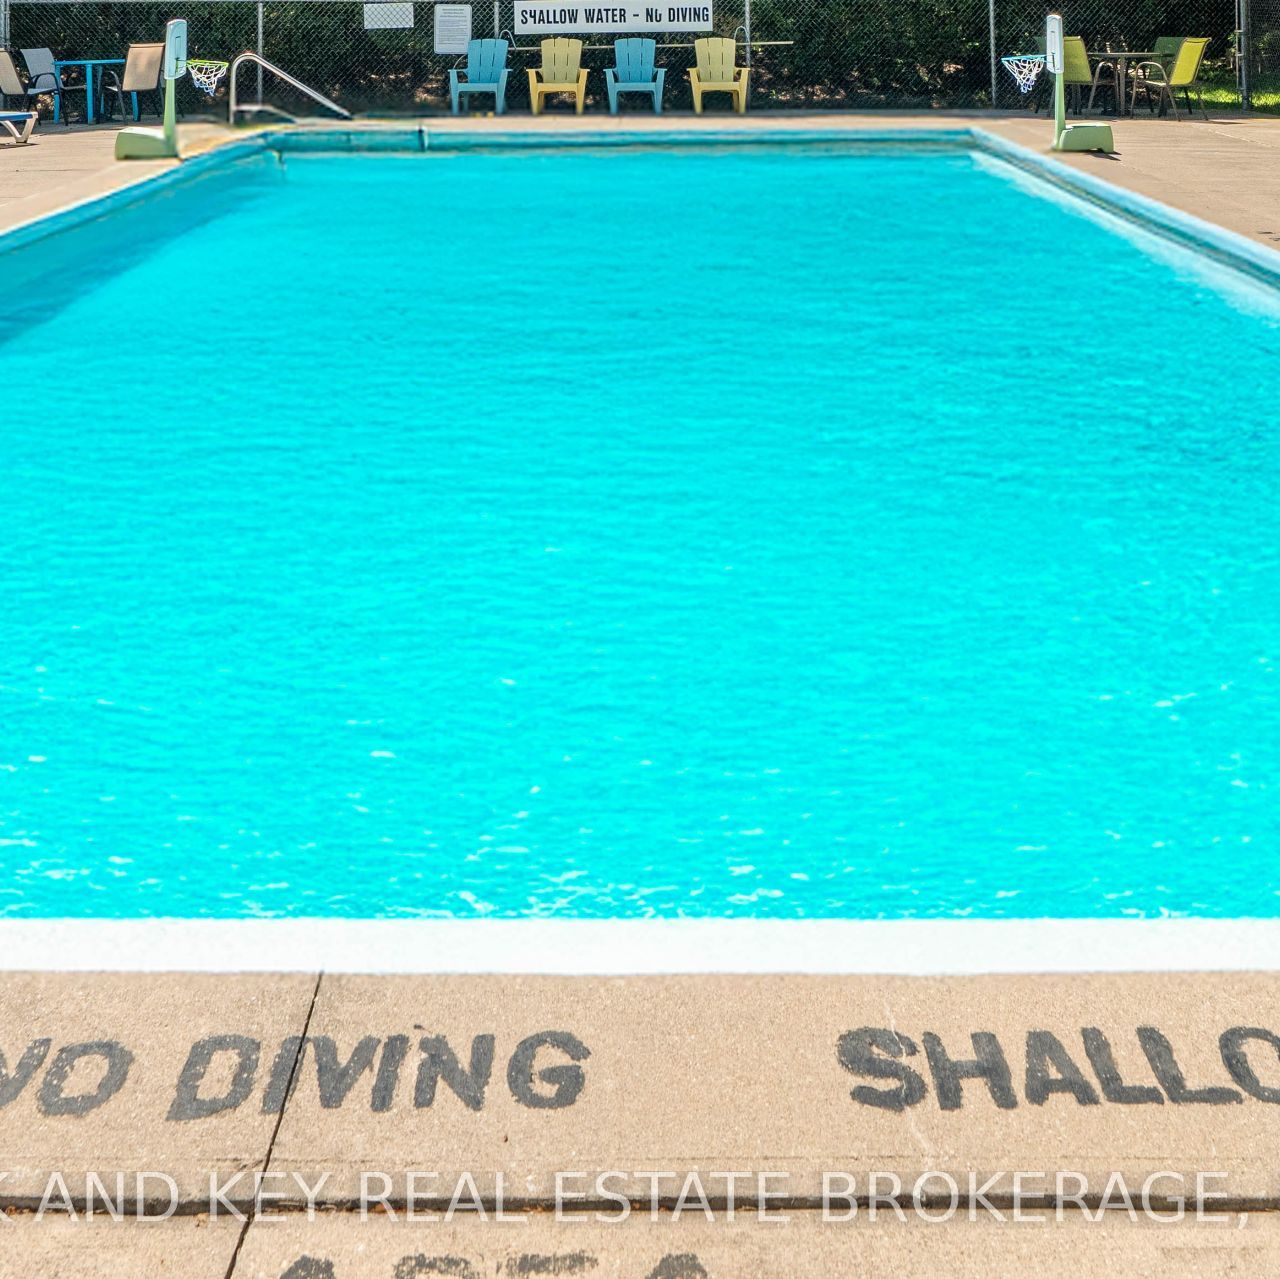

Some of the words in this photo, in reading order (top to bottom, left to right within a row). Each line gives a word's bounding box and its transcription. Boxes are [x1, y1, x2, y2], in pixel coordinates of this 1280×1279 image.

[520, 8, 579, 25] SHALLOW
[584, 7, 627, 24] WATER
[668, 6, 710, 23] DIVING
[166, 1031, 592, 1120] DIVING
